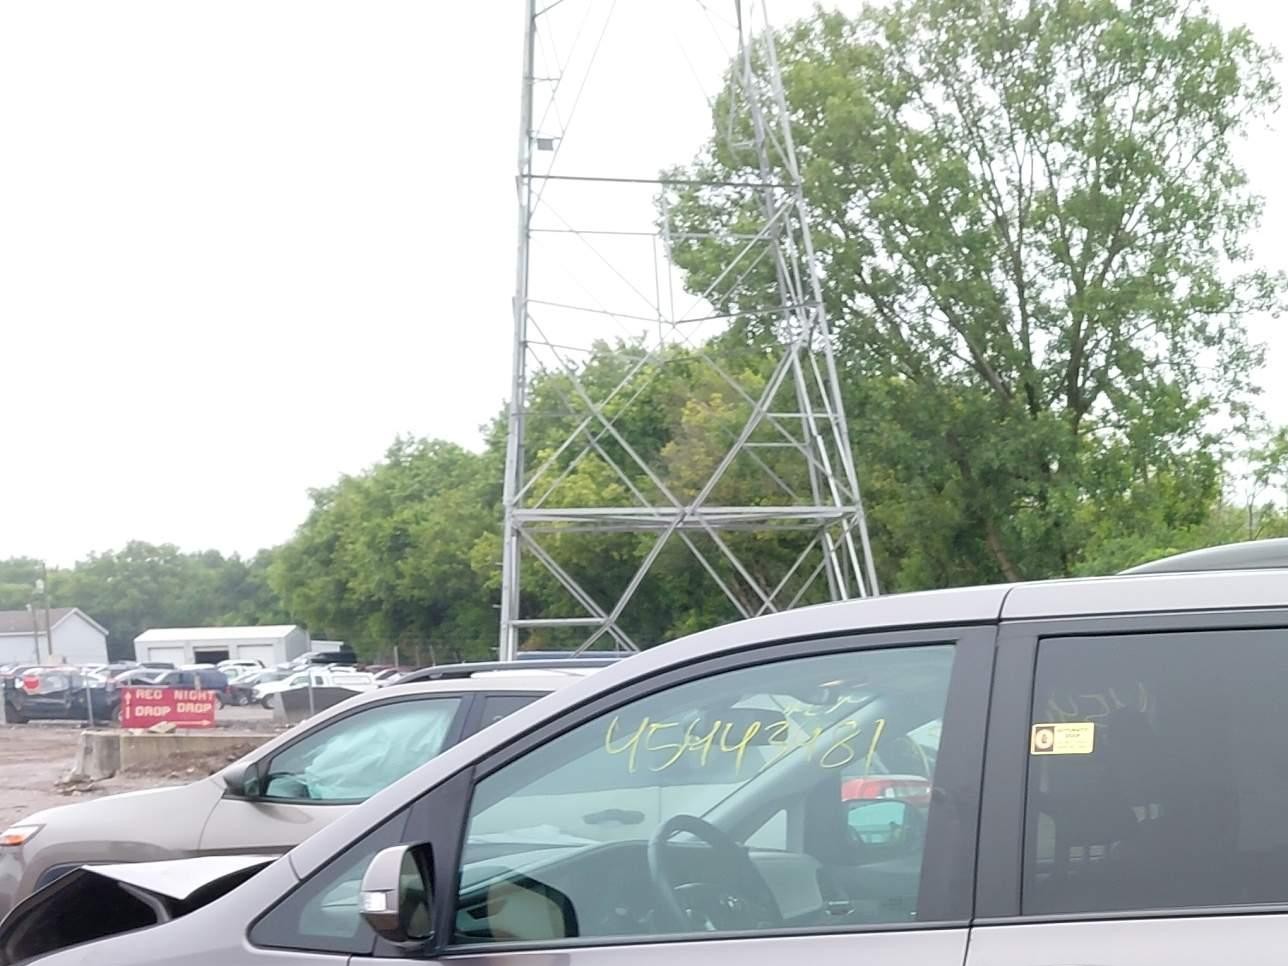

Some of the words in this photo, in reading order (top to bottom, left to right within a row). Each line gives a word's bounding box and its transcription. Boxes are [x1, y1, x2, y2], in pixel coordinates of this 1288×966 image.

[174, 689, 214, 700] NIGHT
[135, 705, 171, 716] DROP
[176, 702, 212, 713] DROP
